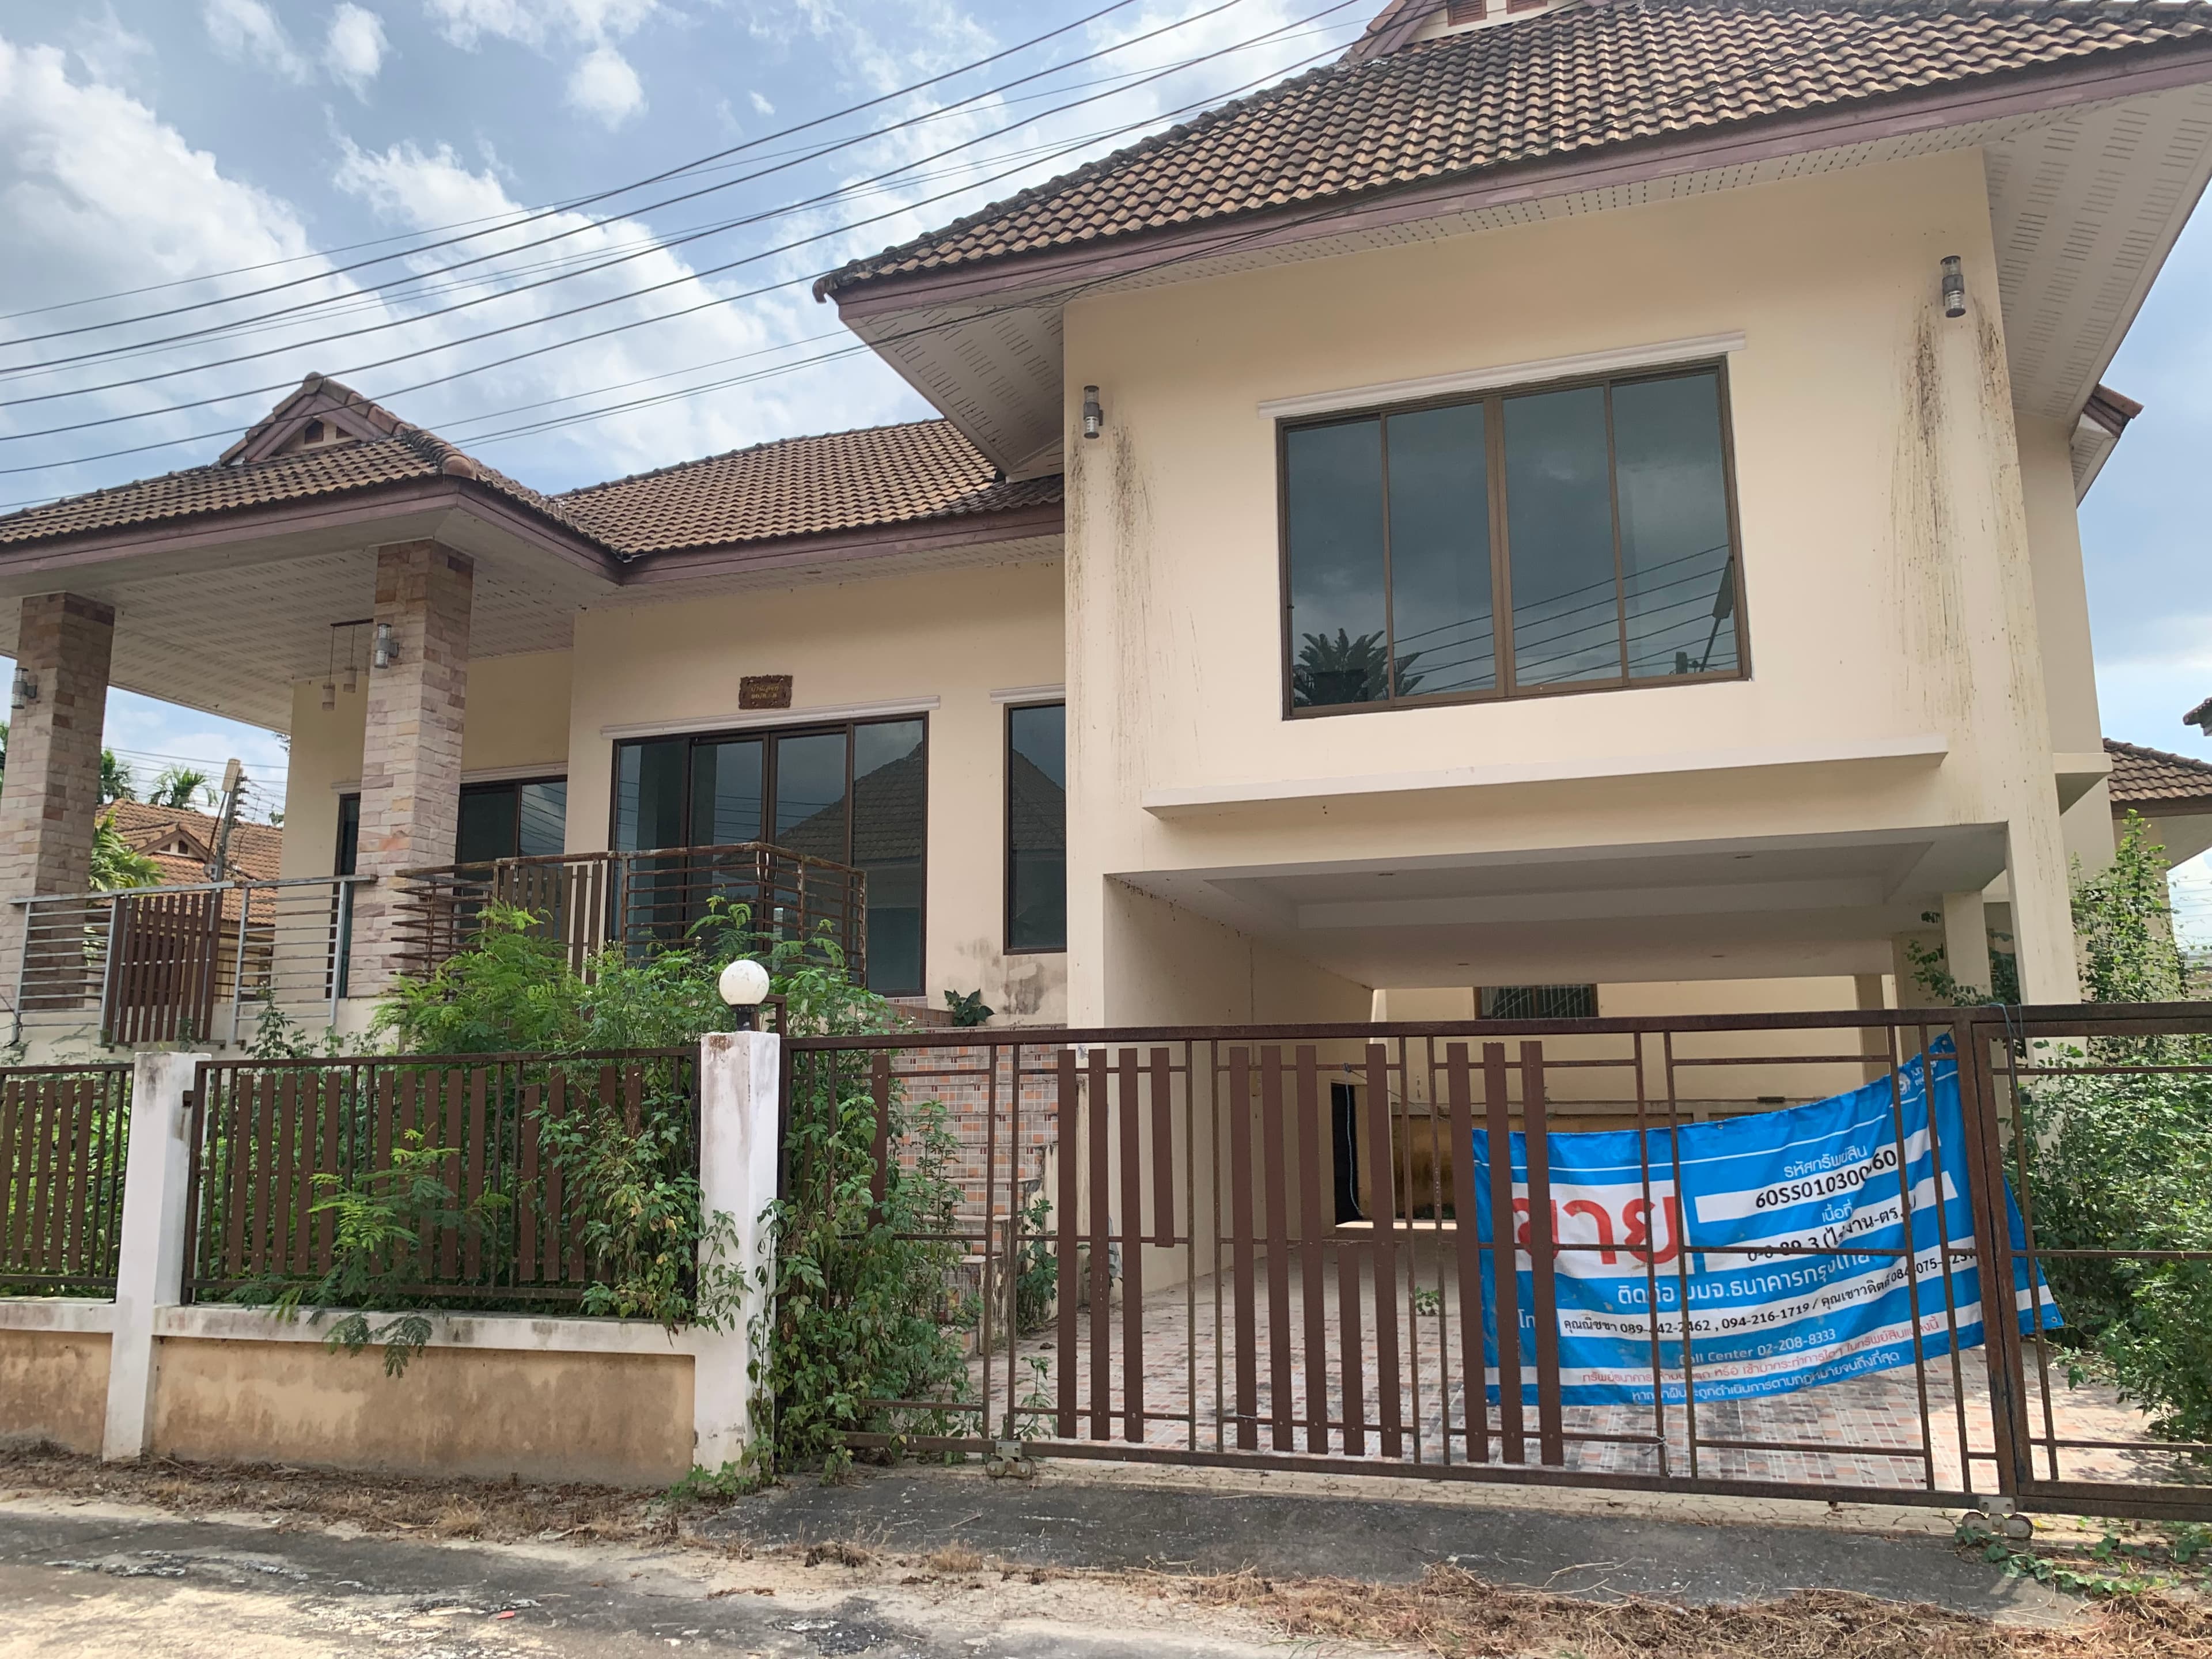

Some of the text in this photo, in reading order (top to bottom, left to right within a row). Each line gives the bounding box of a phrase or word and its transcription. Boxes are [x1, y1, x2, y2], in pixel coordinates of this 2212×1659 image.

[1821, 1199, 1853, 1222] เนื้อที่
[1721, 1302, 1809, 1329] 094-216-1719
[1708, 1349, 1753, 1362] Center
[1758, 1328, 1836, 1356] 02-208-8333
